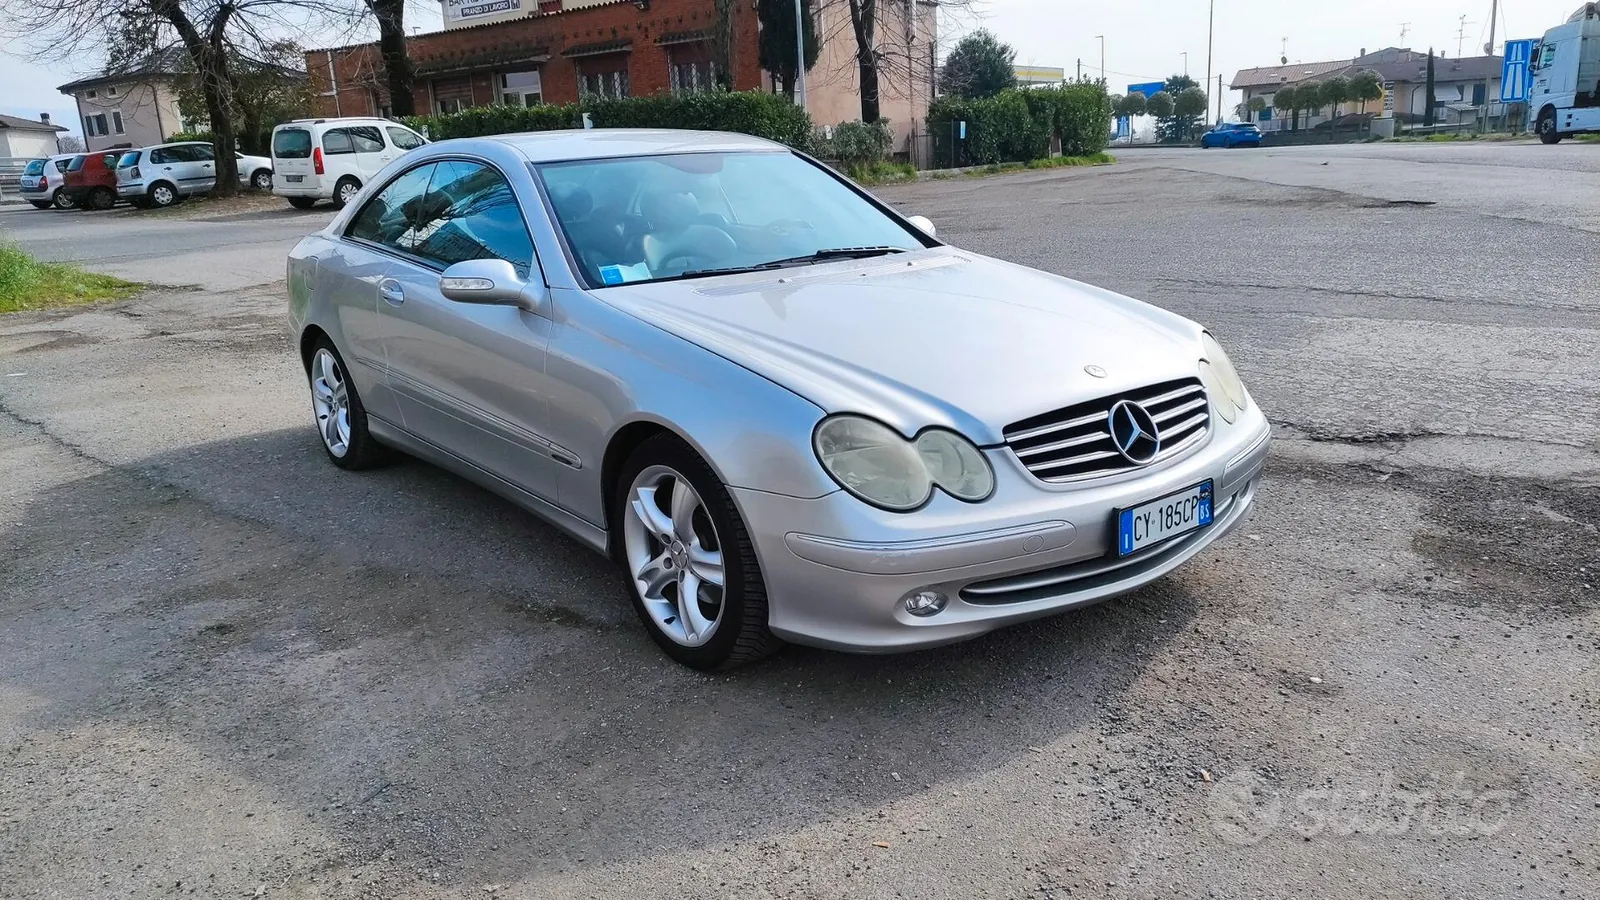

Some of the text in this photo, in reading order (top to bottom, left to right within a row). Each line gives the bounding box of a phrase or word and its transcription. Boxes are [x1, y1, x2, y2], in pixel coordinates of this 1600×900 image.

[463, 8, 483, 16] PRANZO
[489, 2, 508, 10] LAVORO
[1125, 495, 1210, 549] I CY 185CP BS
